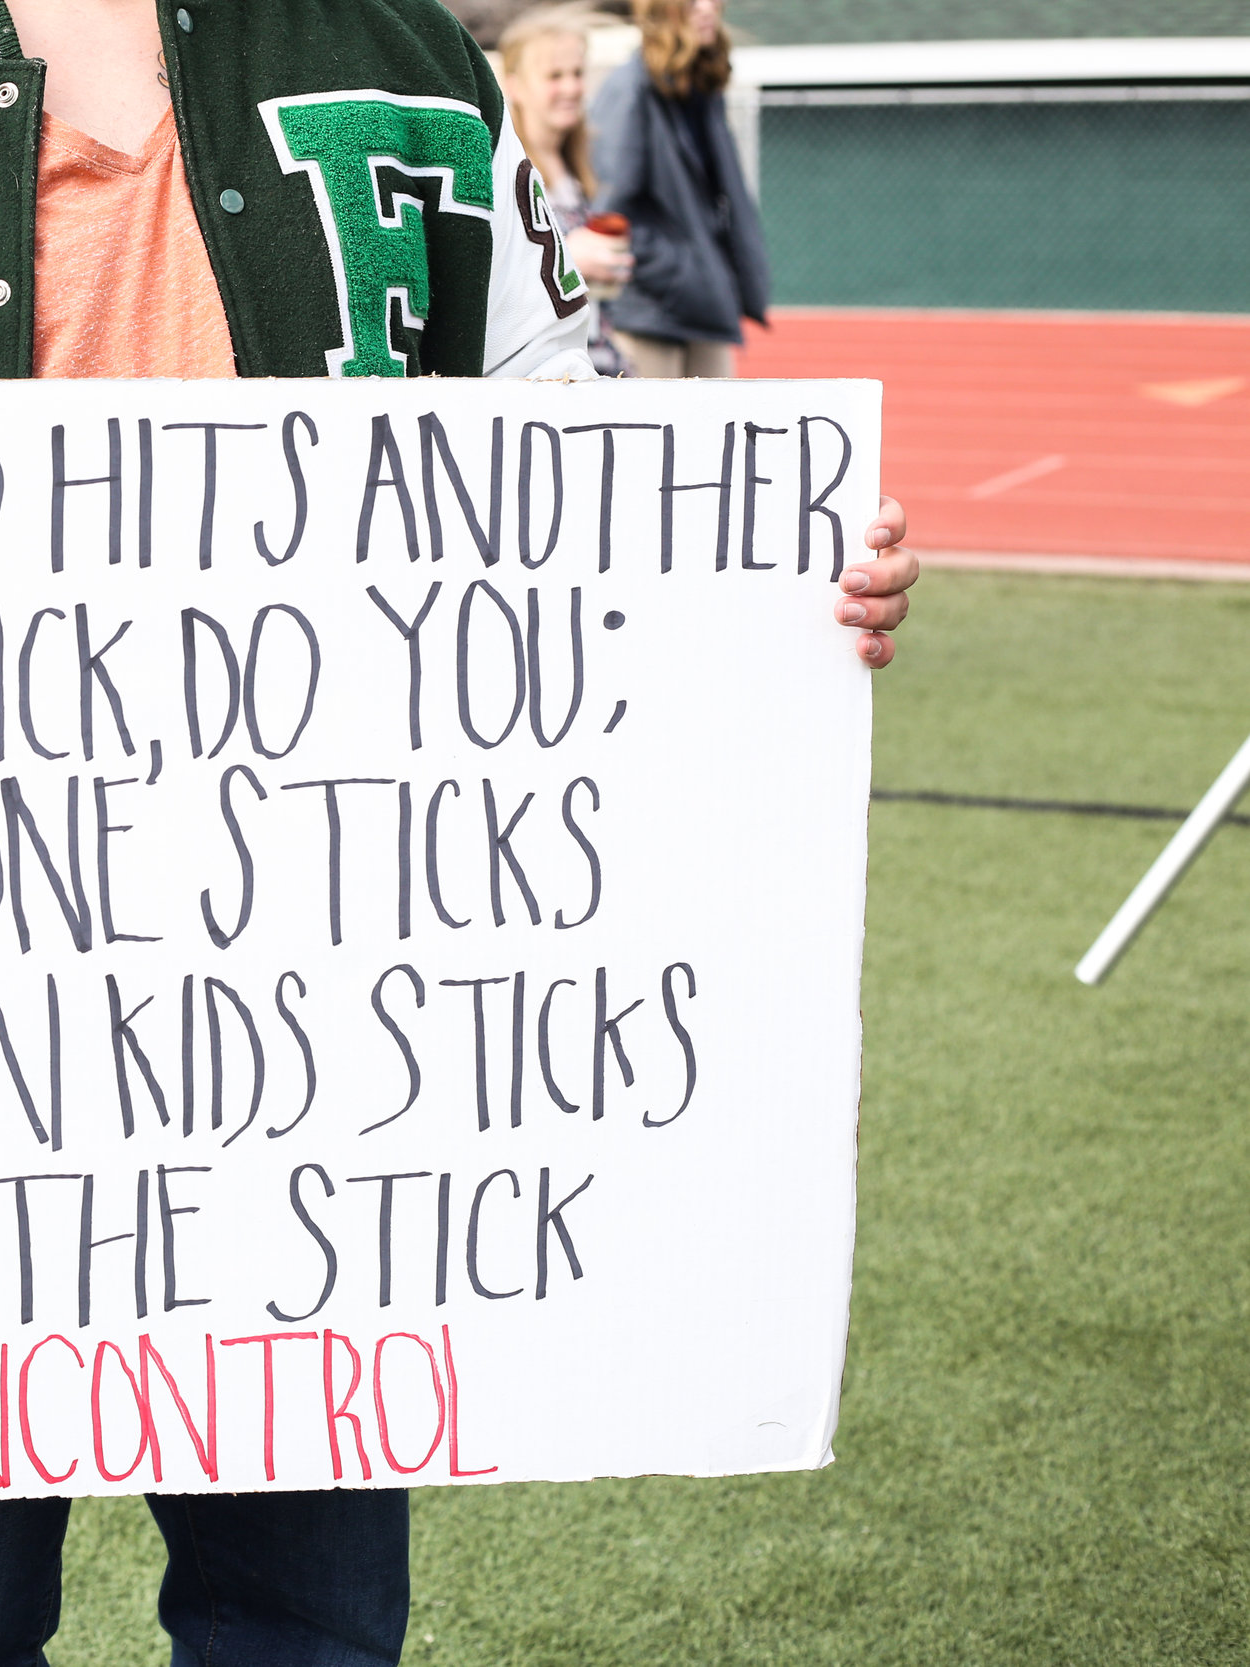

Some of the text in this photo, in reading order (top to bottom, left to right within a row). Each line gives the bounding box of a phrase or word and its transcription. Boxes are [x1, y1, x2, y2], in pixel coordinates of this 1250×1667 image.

[257, 88, 494, 377] F
[50, 410, 319, 574] HITS
[356, 411, 852, 583] ANOTHER
[200, 764, 602, 951] STICKS
[105, 970, 317, 1148] KIDS
[358, 962, 697, 1136] STICKS
[265, 1163, 595, 1323] STICK
